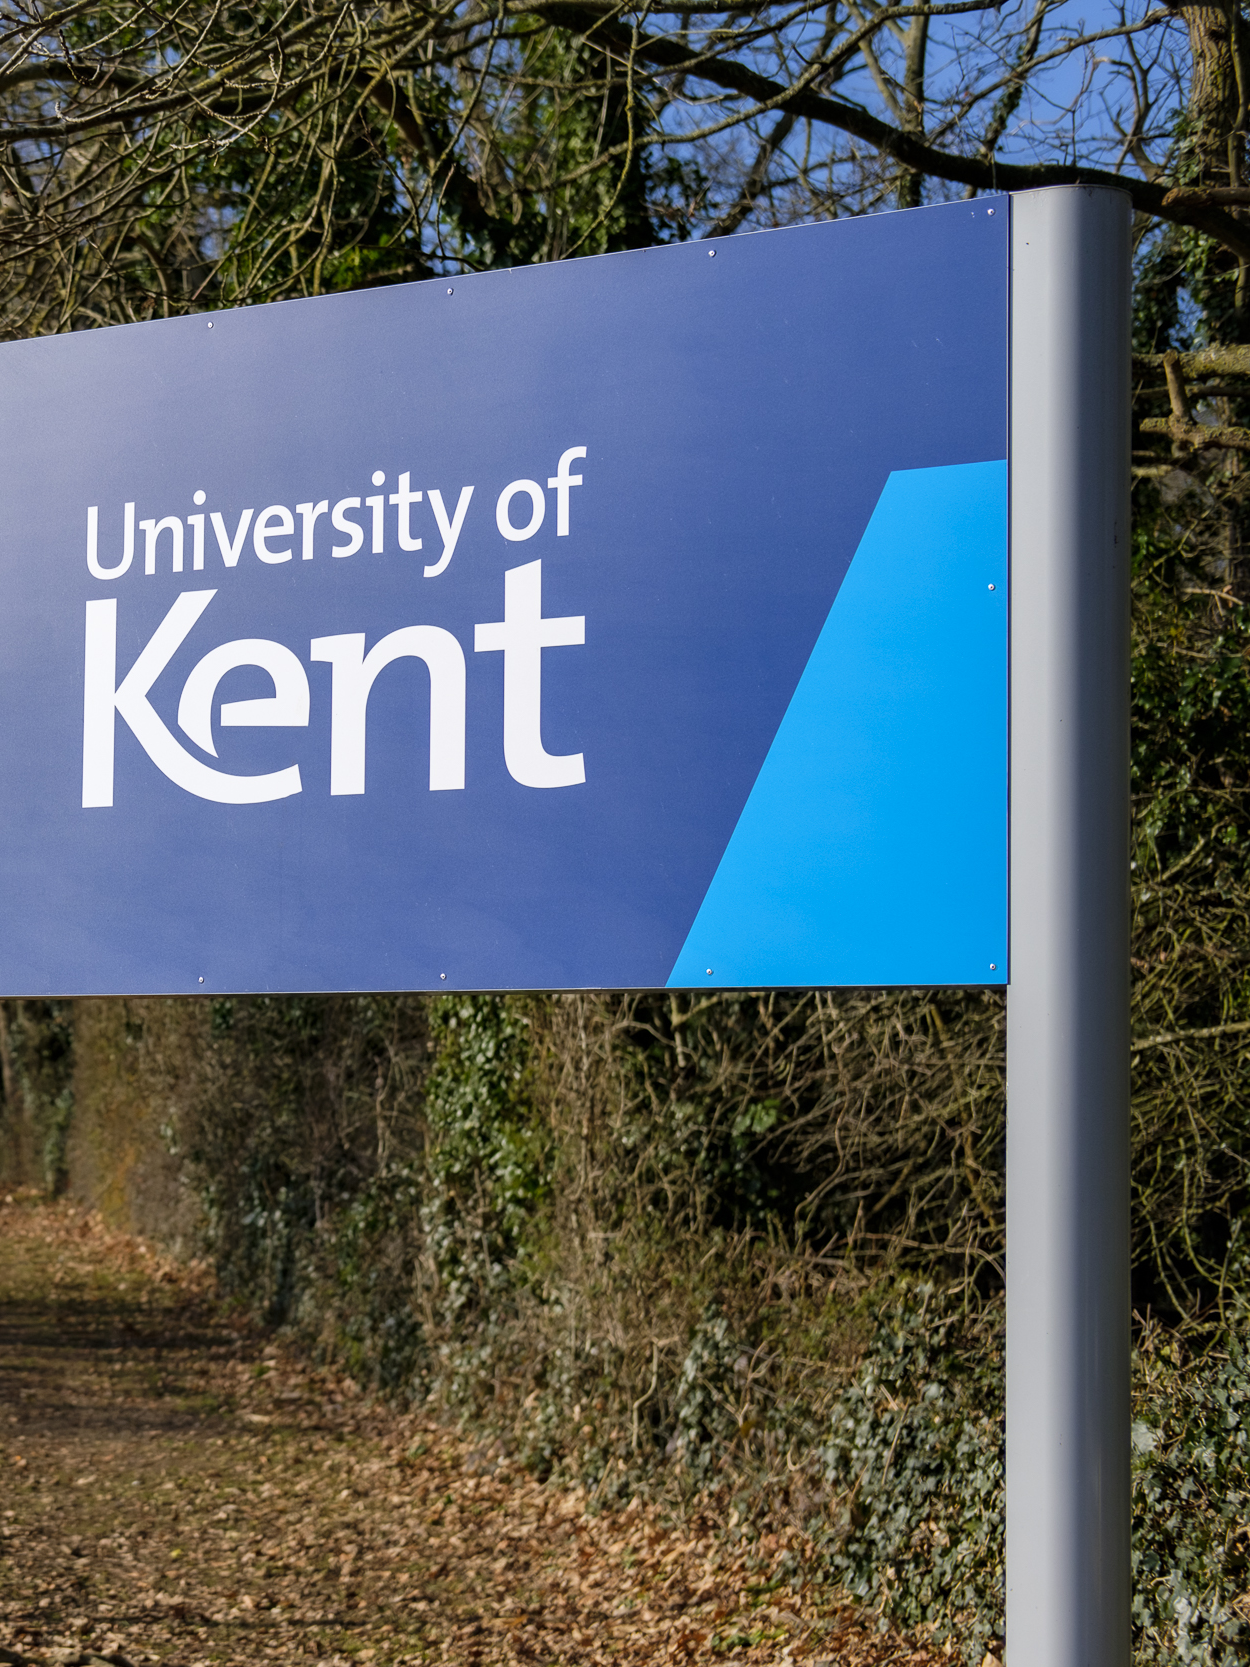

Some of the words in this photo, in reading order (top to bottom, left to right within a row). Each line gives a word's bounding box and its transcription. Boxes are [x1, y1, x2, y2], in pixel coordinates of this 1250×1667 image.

[86, 469, 475, 580] University
[495, 445, 587, 542] of
[81, 558, 586, 809] Kent
